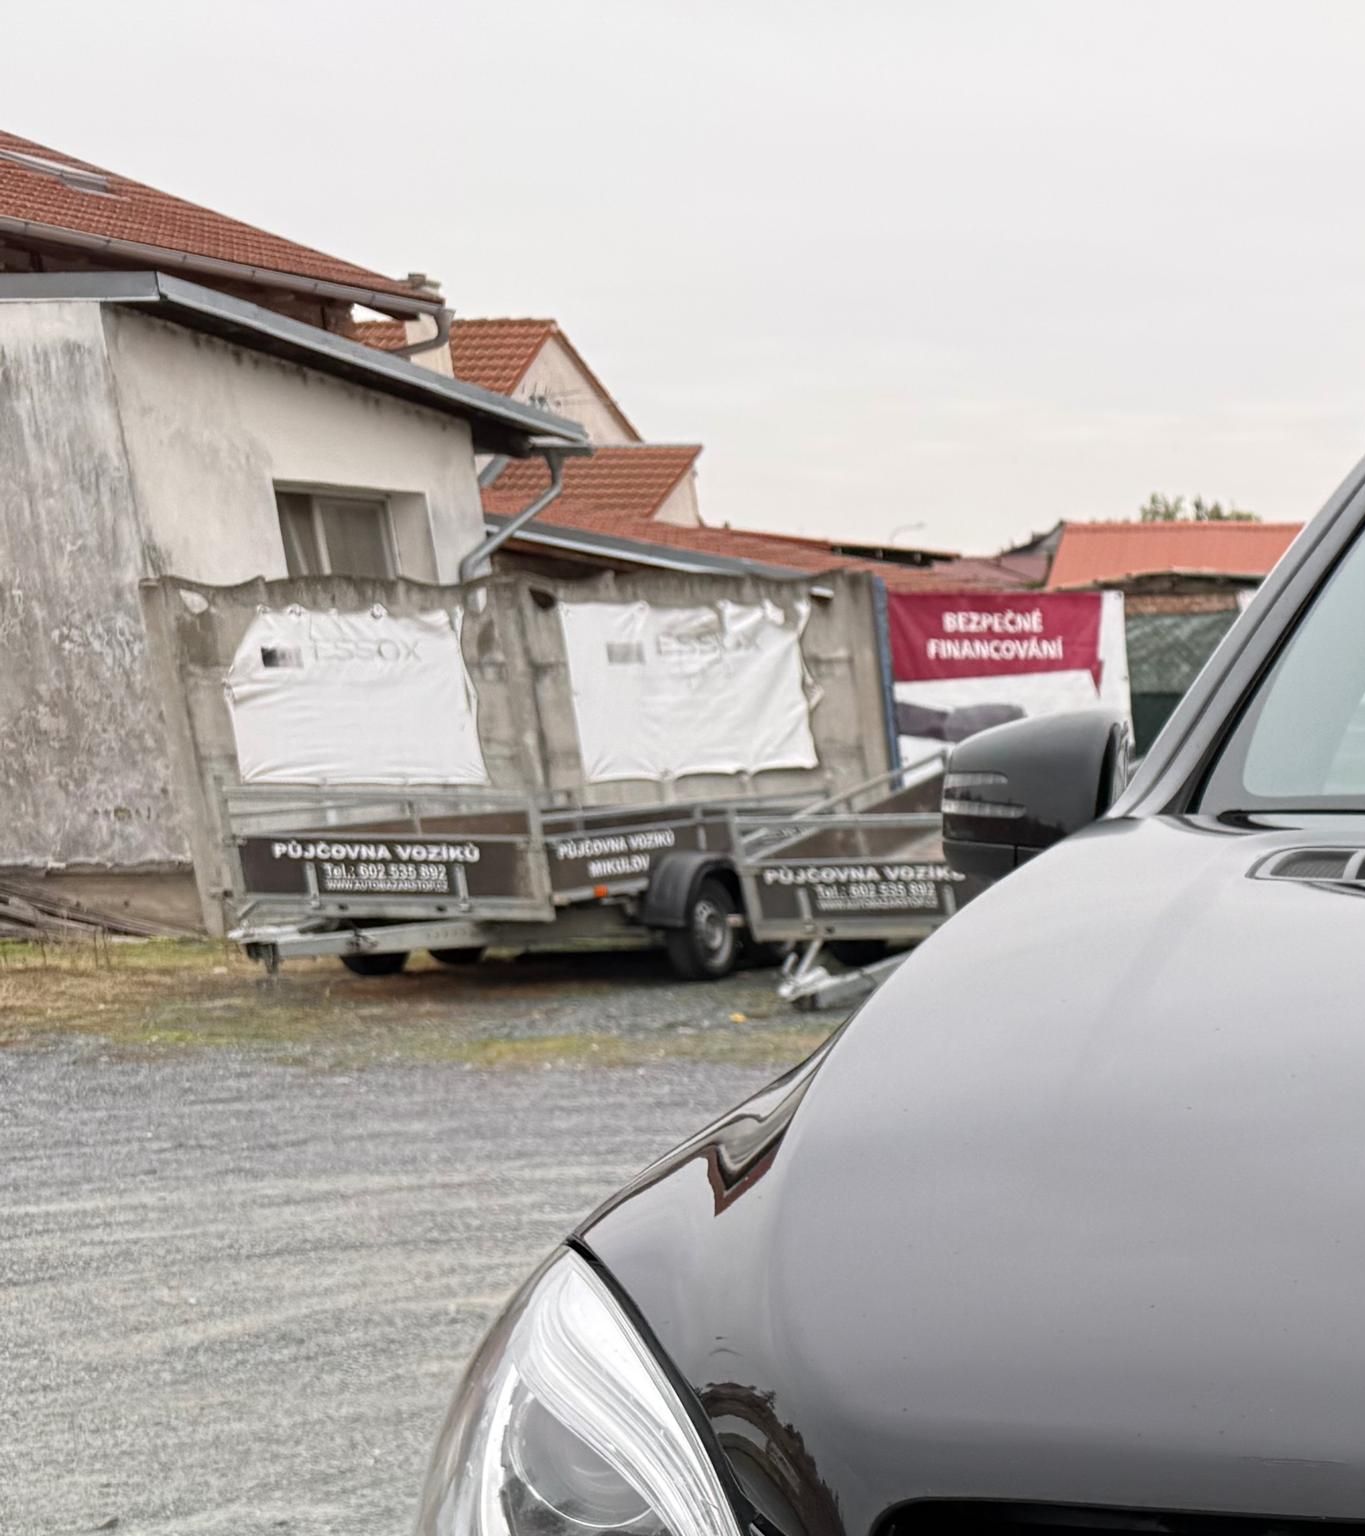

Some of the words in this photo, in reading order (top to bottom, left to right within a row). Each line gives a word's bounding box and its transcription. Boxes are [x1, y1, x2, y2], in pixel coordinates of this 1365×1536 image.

[942, 608, 1043, 633] BEZPEČNÉ
[926, 636, 1063, 660] FINANCOVÁNÍ
[272, 841, 392, 860] PŮJČOVNA
[396, 842, 481, 863] VOZÍKŮ
[557, 835, 629, 860] PŮJČOVNA
[358, 863, 387, 880] 602
[389, 863, 417, 880] 535
[419, 863, 447, 880] 892
[588, 853, 650, 878] MIKULOV
[764, 866, 880, 885] PŮJČOVNA
